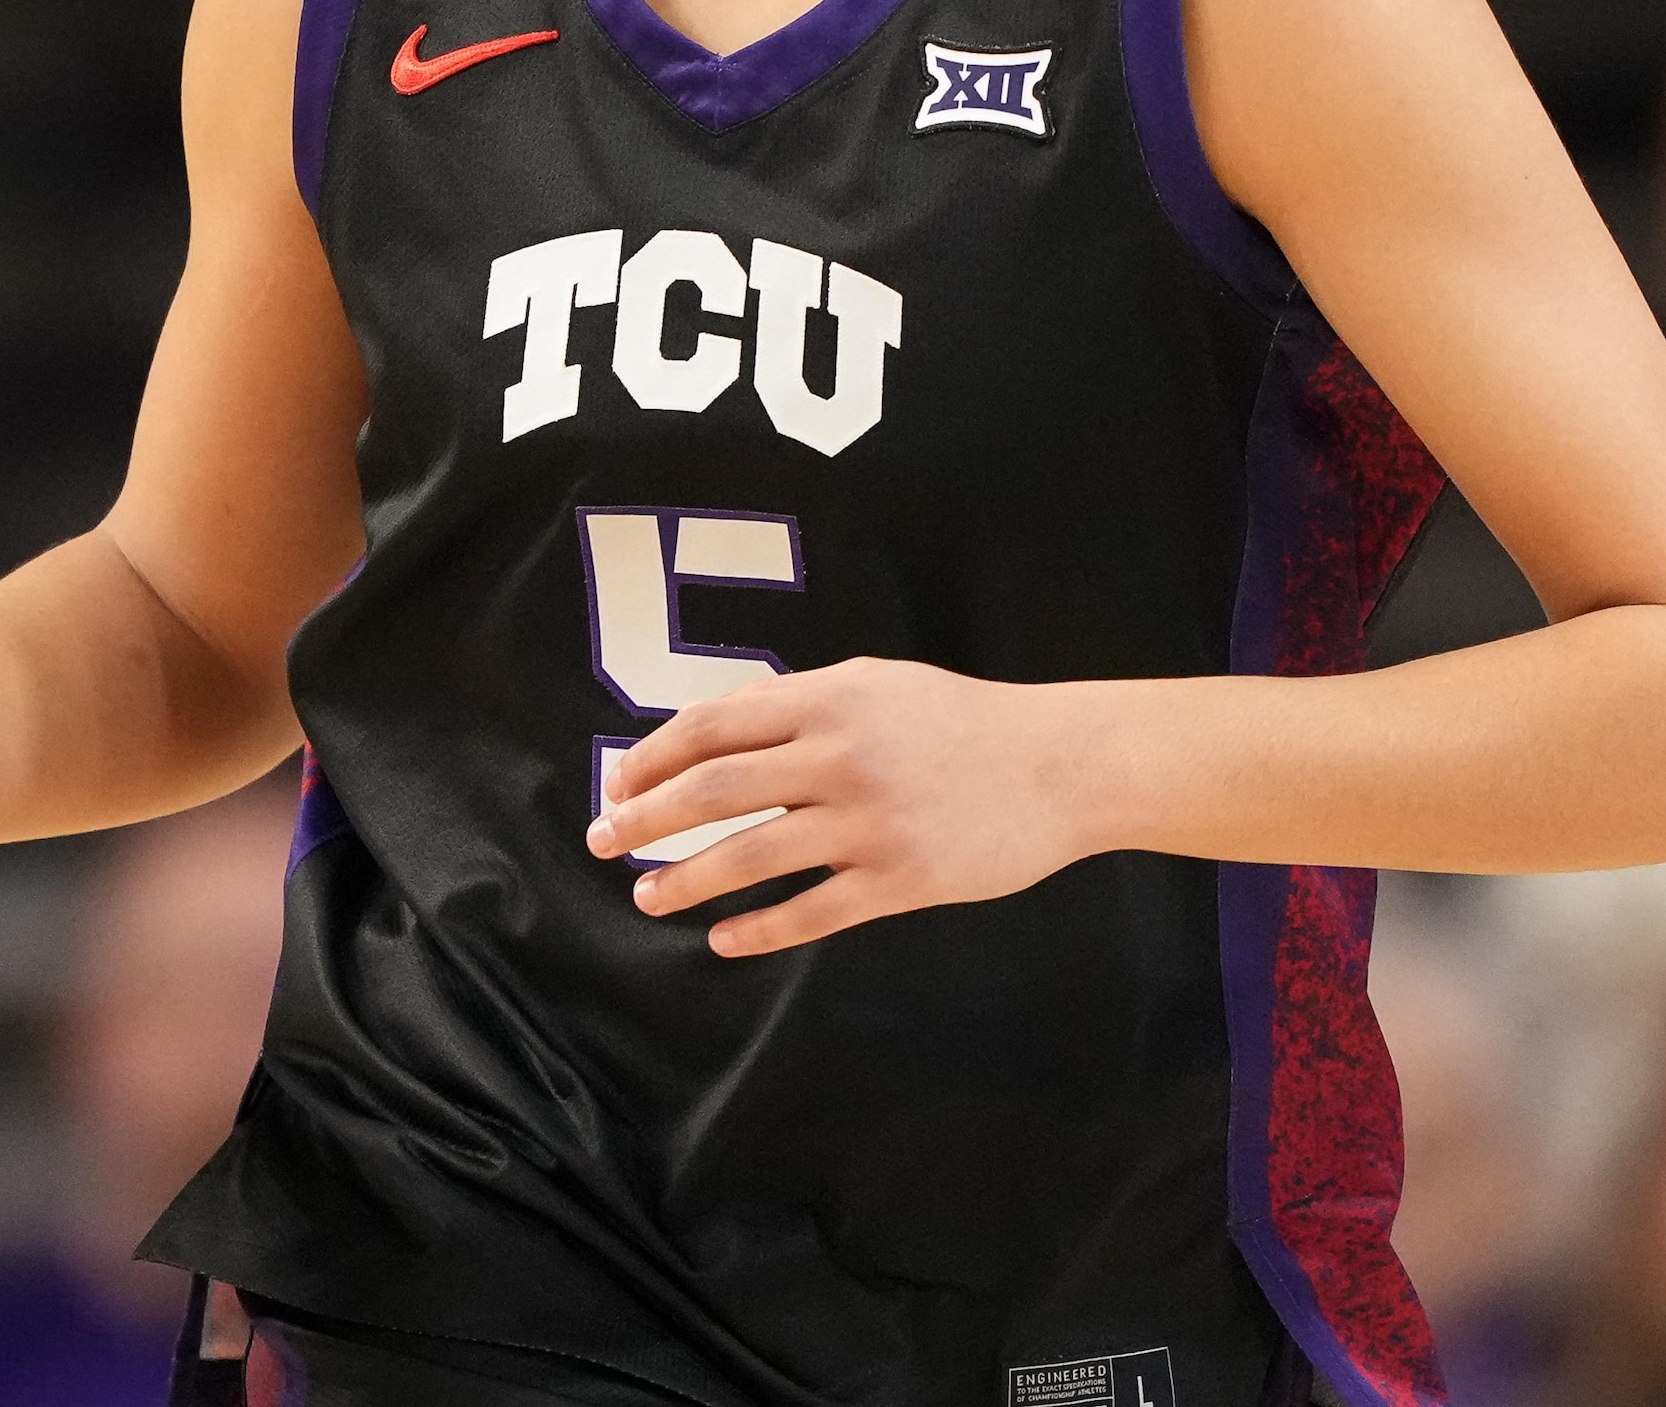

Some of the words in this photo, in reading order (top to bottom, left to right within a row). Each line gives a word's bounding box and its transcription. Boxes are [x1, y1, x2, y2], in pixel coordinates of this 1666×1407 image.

[482, 228, 904, 459] TCU
[575, 505, 807, 871] 5
[1017, 1365, 1106, 1386] ENGINEERED
[1016, 1395, 1025, 1403] OF
[1077, 1385, 1107, 1396] ATHLETES
[1017, 1387, 1027, 1395] TO
[1027, 1384, 1040, 1394] THE
[1041, 1383, 1062, 1393] EXACT
[1137, 1376, 1154, 1407] L
